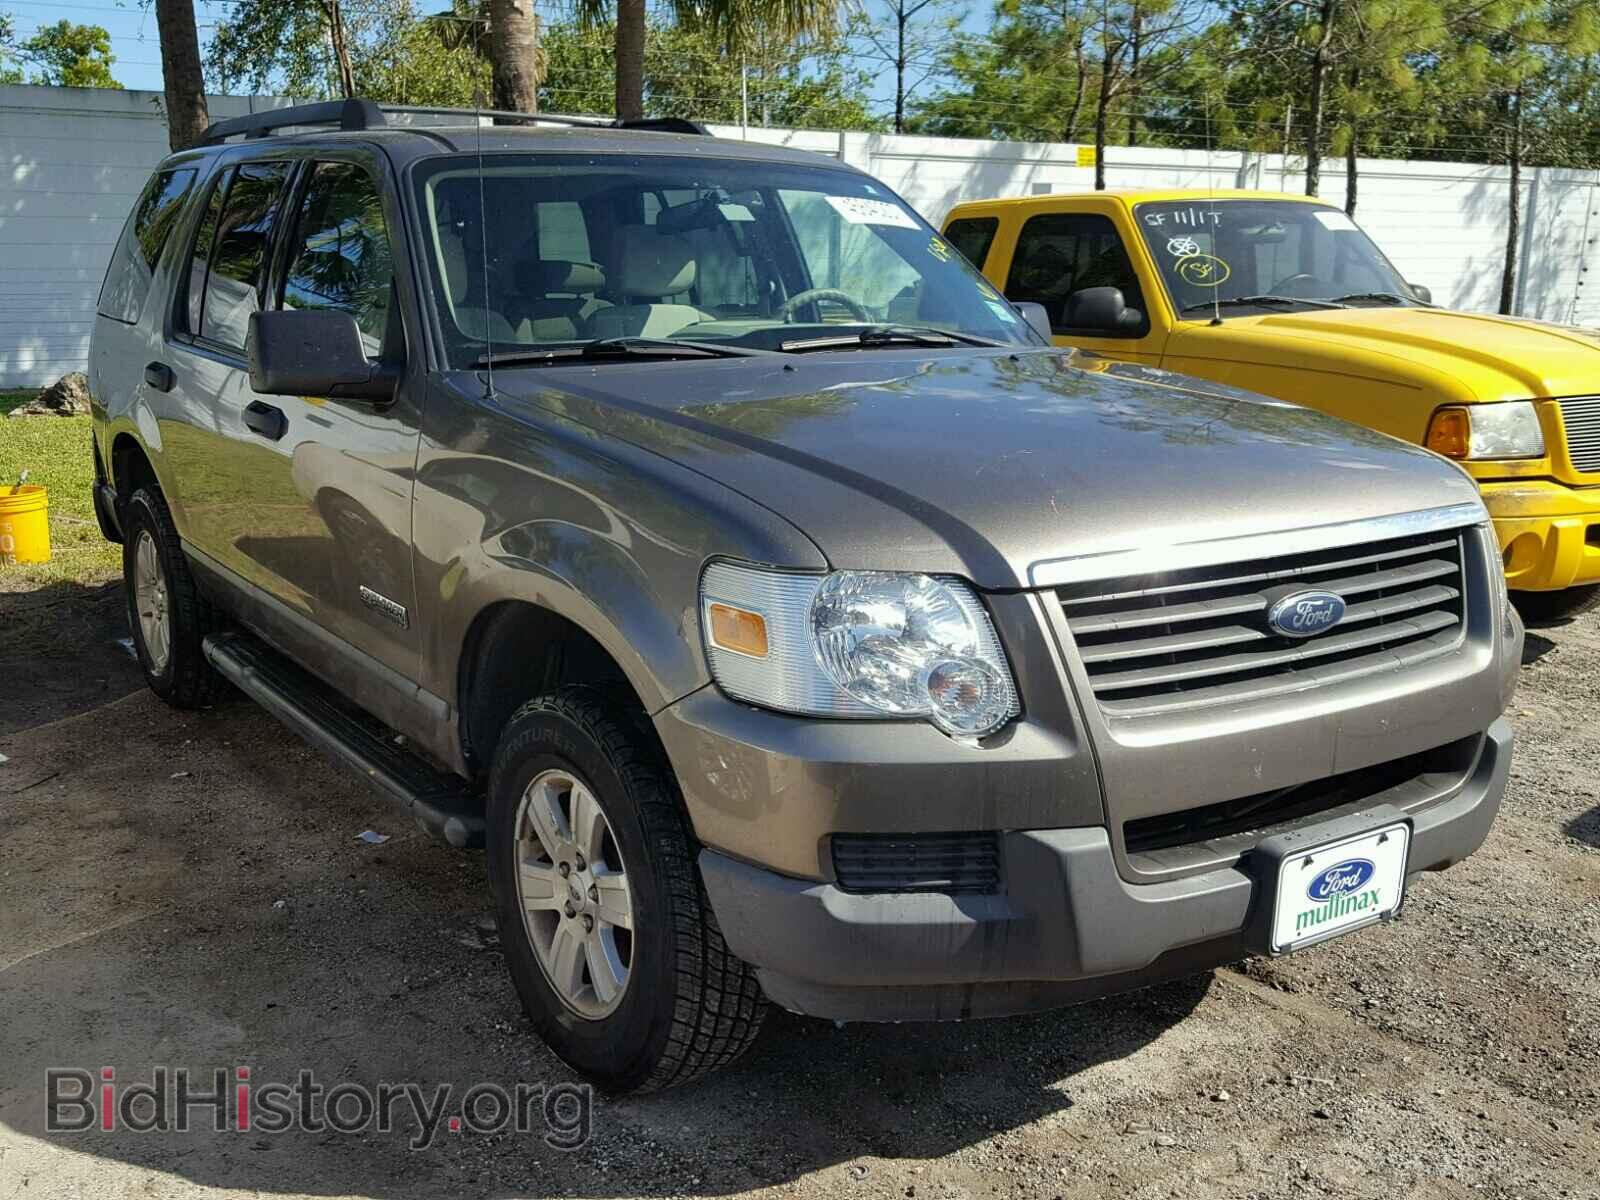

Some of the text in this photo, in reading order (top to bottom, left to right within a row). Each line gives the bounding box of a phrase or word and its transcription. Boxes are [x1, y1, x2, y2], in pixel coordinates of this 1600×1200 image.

[1293, 600, 1334, 628] Ford
[1319, 865, 1362, 896] Ford
[1296, 888, 1381, 931] mullinax
